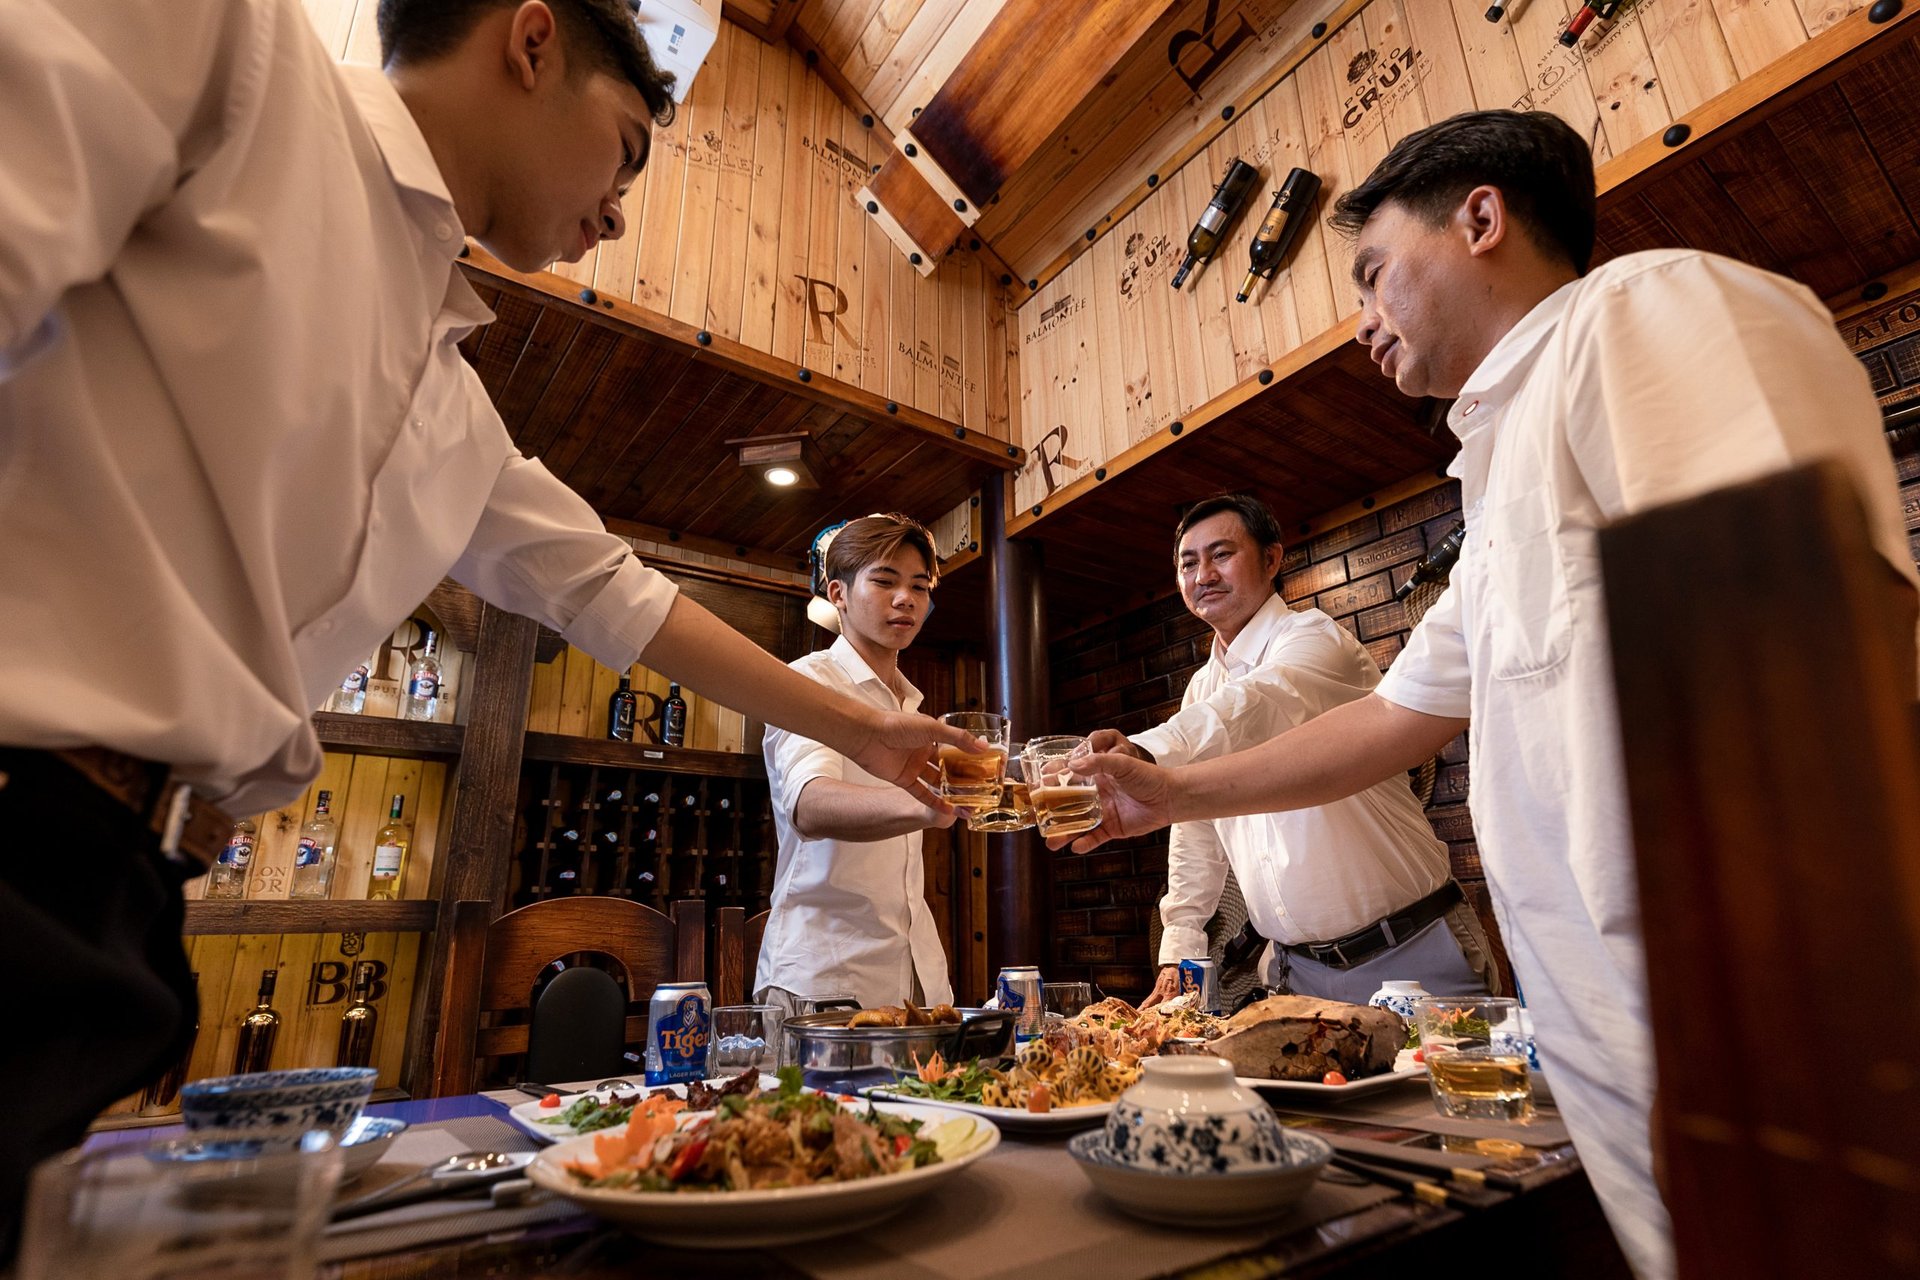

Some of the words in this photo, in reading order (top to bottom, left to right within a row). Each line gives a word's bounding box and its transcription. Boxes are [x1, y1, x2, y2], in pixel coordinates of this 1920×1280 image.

[1593, 28, 1622, 57] QUALITY
[1343, 46, 1423, 129] CRUZ
[794, 274, 870, 352] R
[1357, 549, 1388, 567] Ballon
[661, 1026, 708, 1058] Tiger
